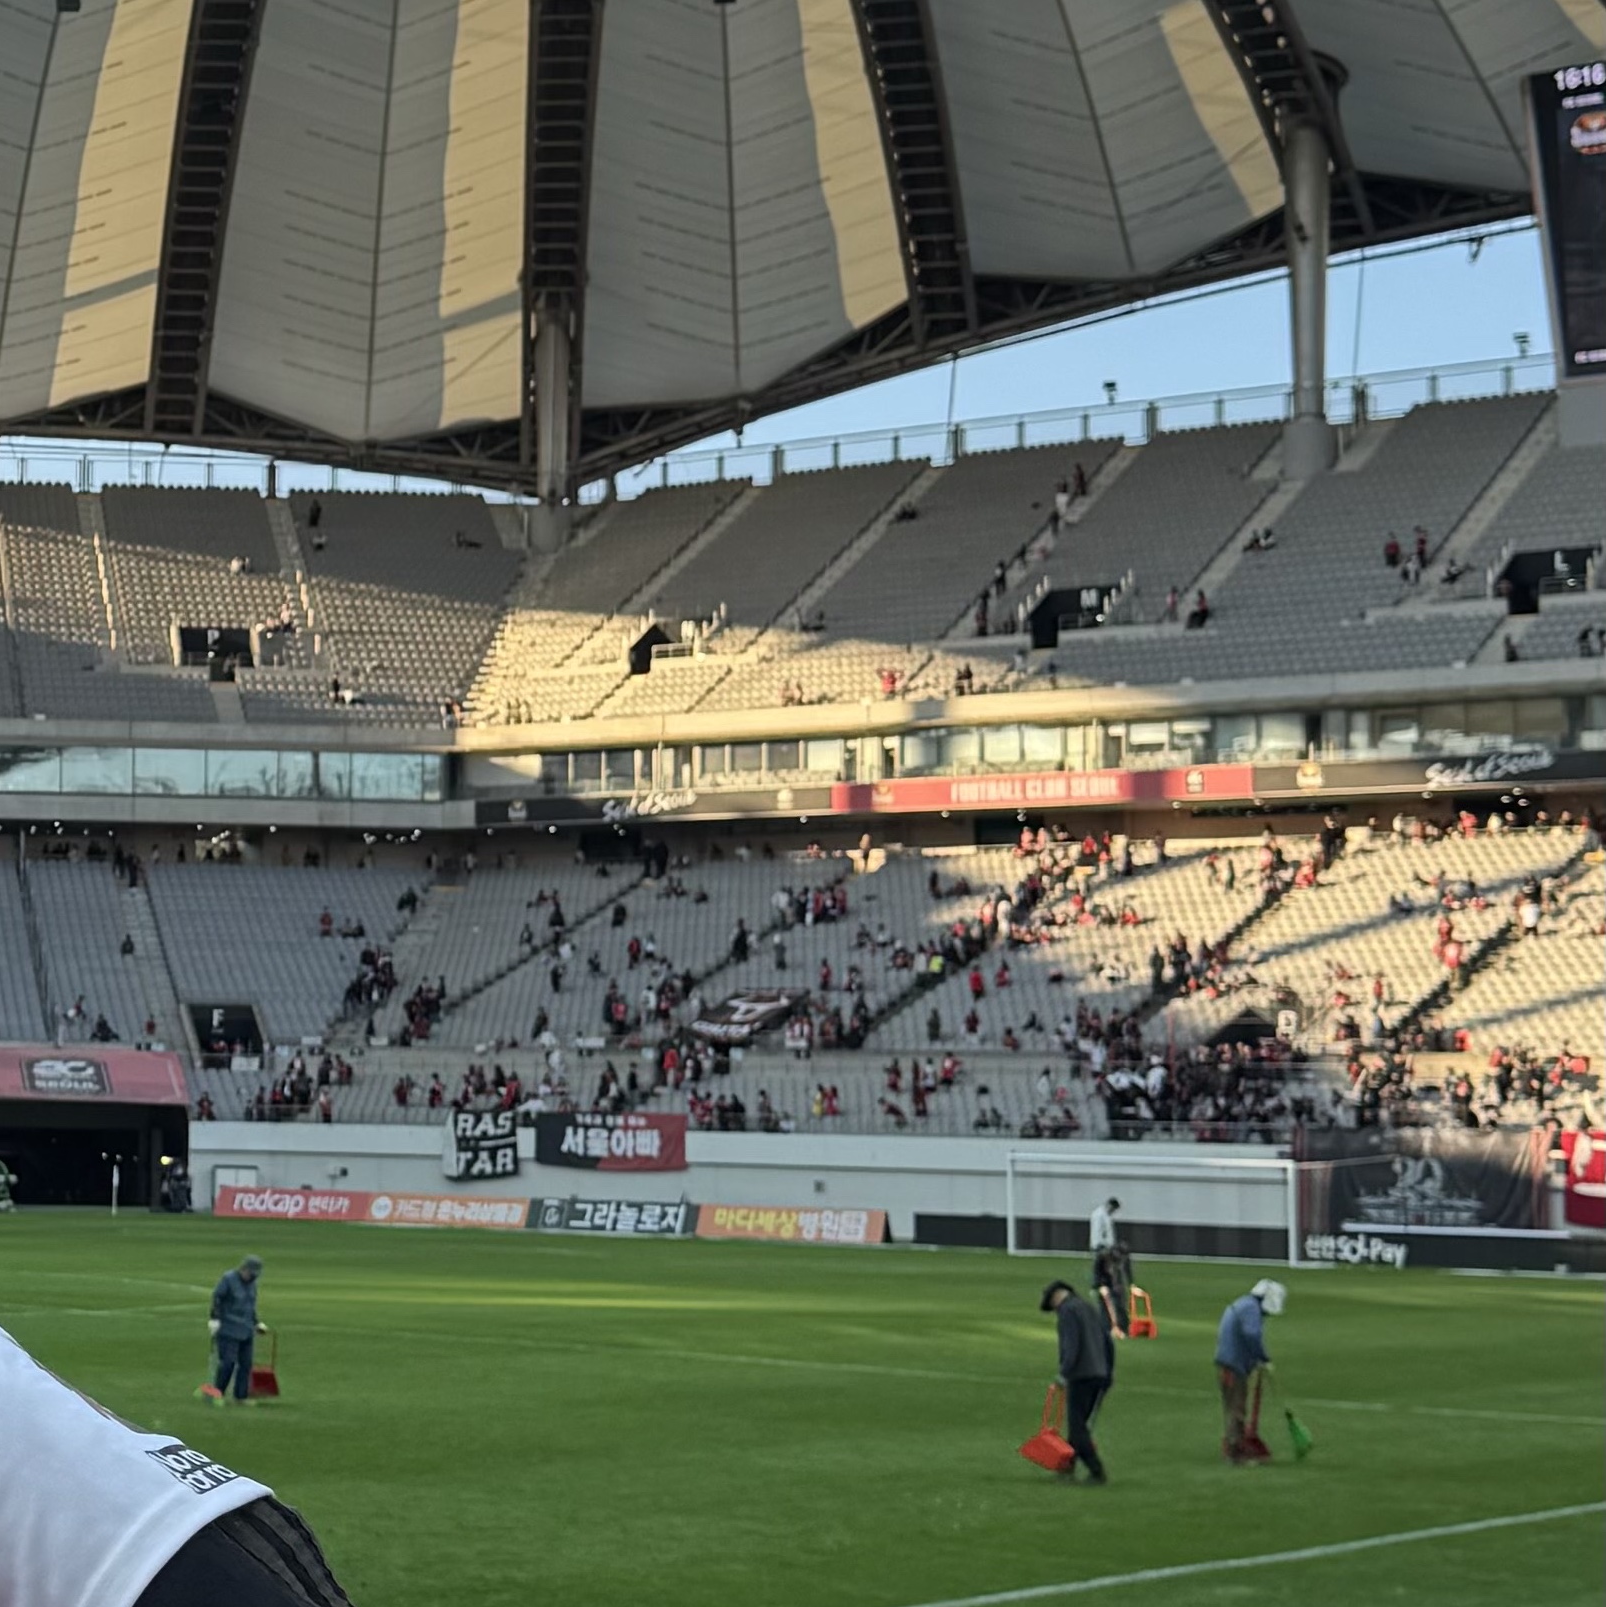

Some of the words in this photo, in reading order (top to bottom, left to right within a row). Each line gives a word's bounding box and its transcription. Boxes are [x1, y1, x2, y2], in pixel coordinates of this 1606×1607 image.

[457, 1112, 514, 1137] RAS
[233, 1189, 305, 1218] redcap
[569, 1202, 687, 1236] 그라놀로지
